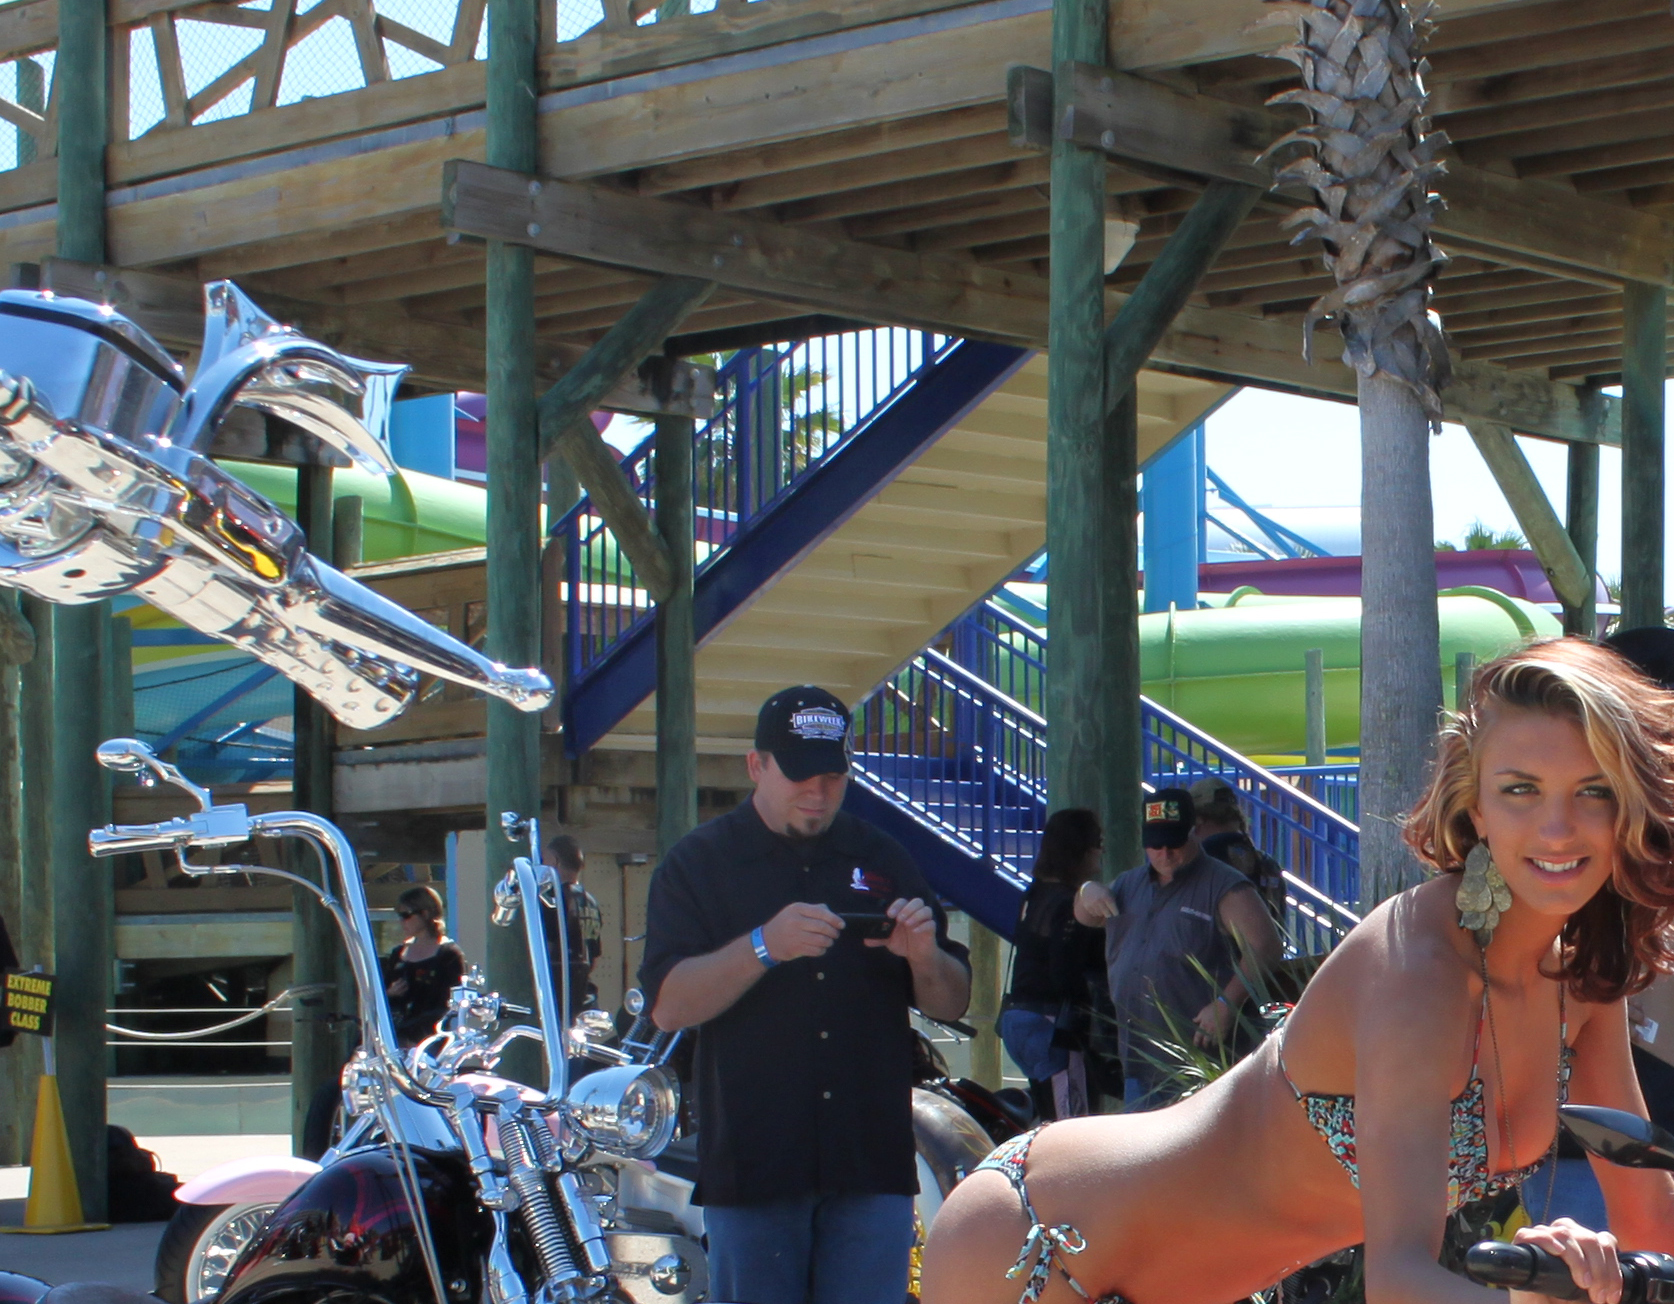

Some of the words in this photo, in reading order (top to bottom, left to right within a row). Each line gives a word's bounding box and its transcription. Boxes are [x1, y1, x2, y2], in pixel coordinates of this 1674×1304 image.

[7, 974, 52, 996] EXTREME
[7, 992, 48, 1013] BOBBER
[10, 1011, 41, 1031] CLASS
